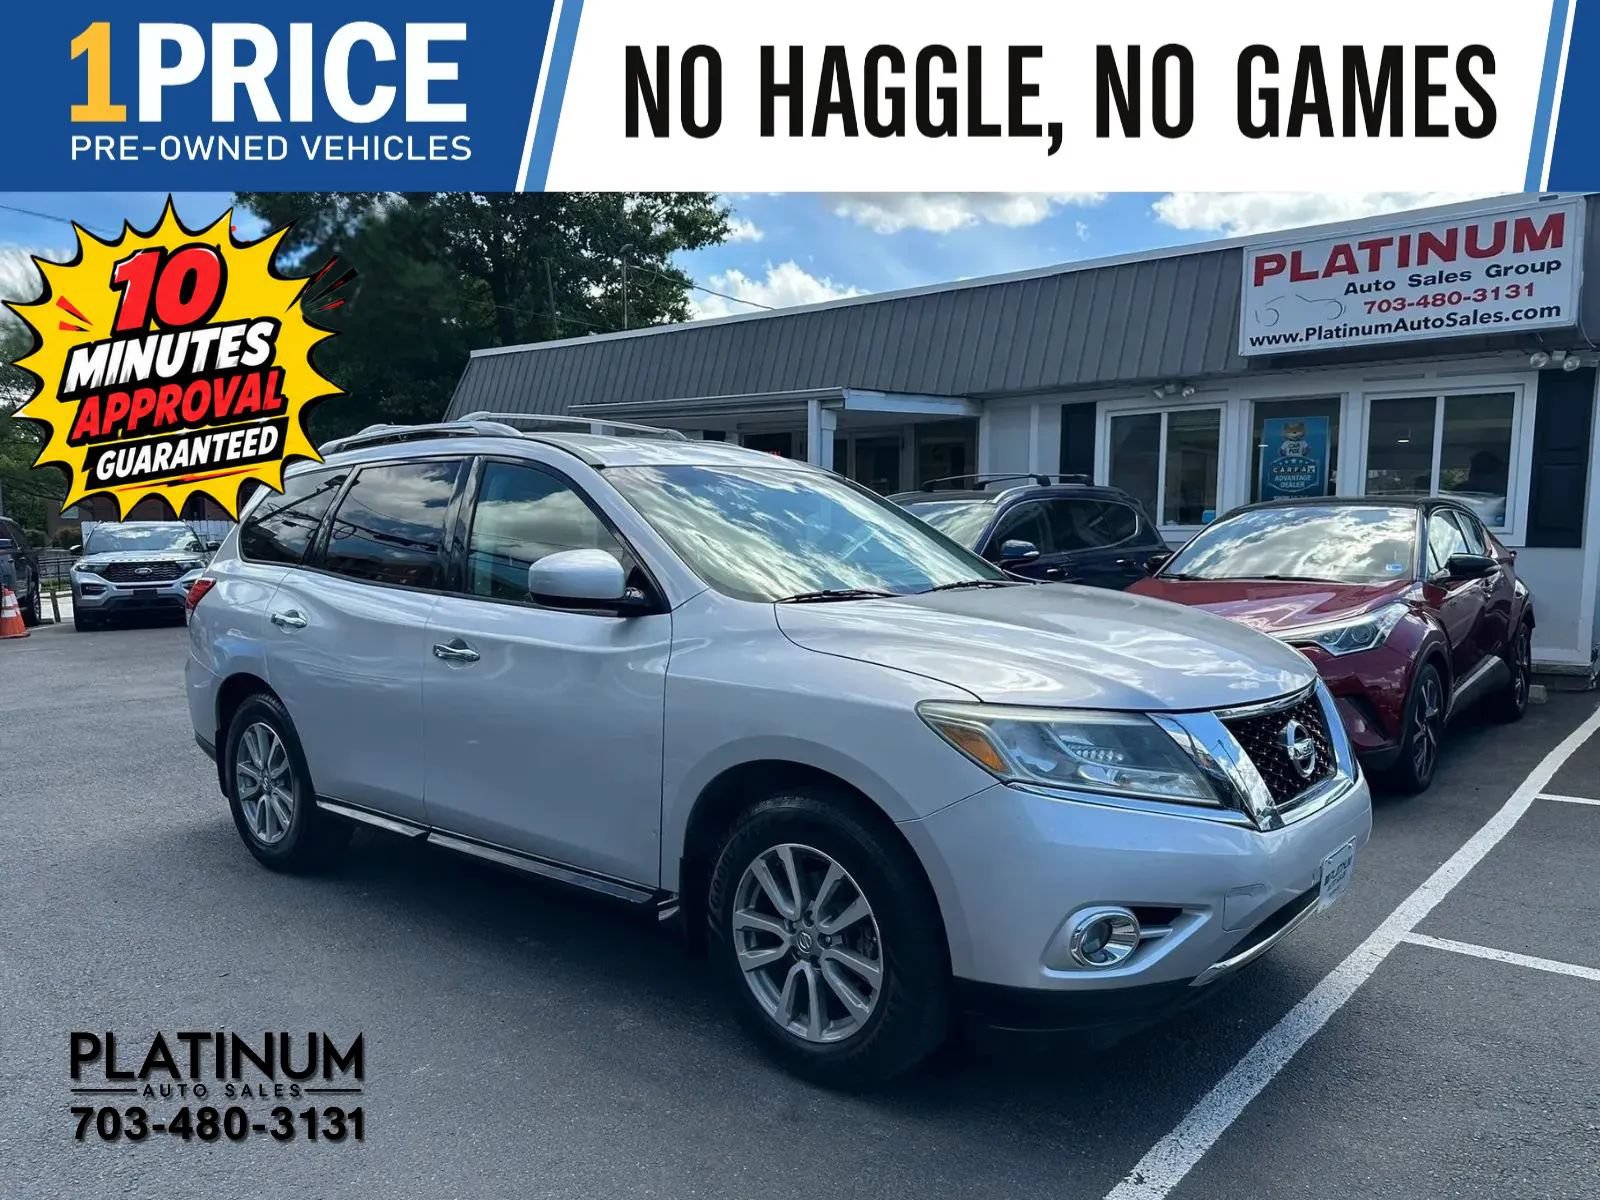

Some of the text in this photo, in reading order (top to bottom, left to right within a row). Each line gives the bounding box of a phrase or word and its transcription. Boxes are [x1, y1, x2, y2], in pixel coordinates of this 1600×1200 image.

[1254, 212, 1565, 287] PLATINUM
[1344, 259, 1562, 296] Auto Sales Group
[1364, 281, 1534, 315] 703-480-3131
[1250, 305, 1561, 347] www.PlatinumAutoSales.com
[1273, 465, 1316, 473] CARFAX
